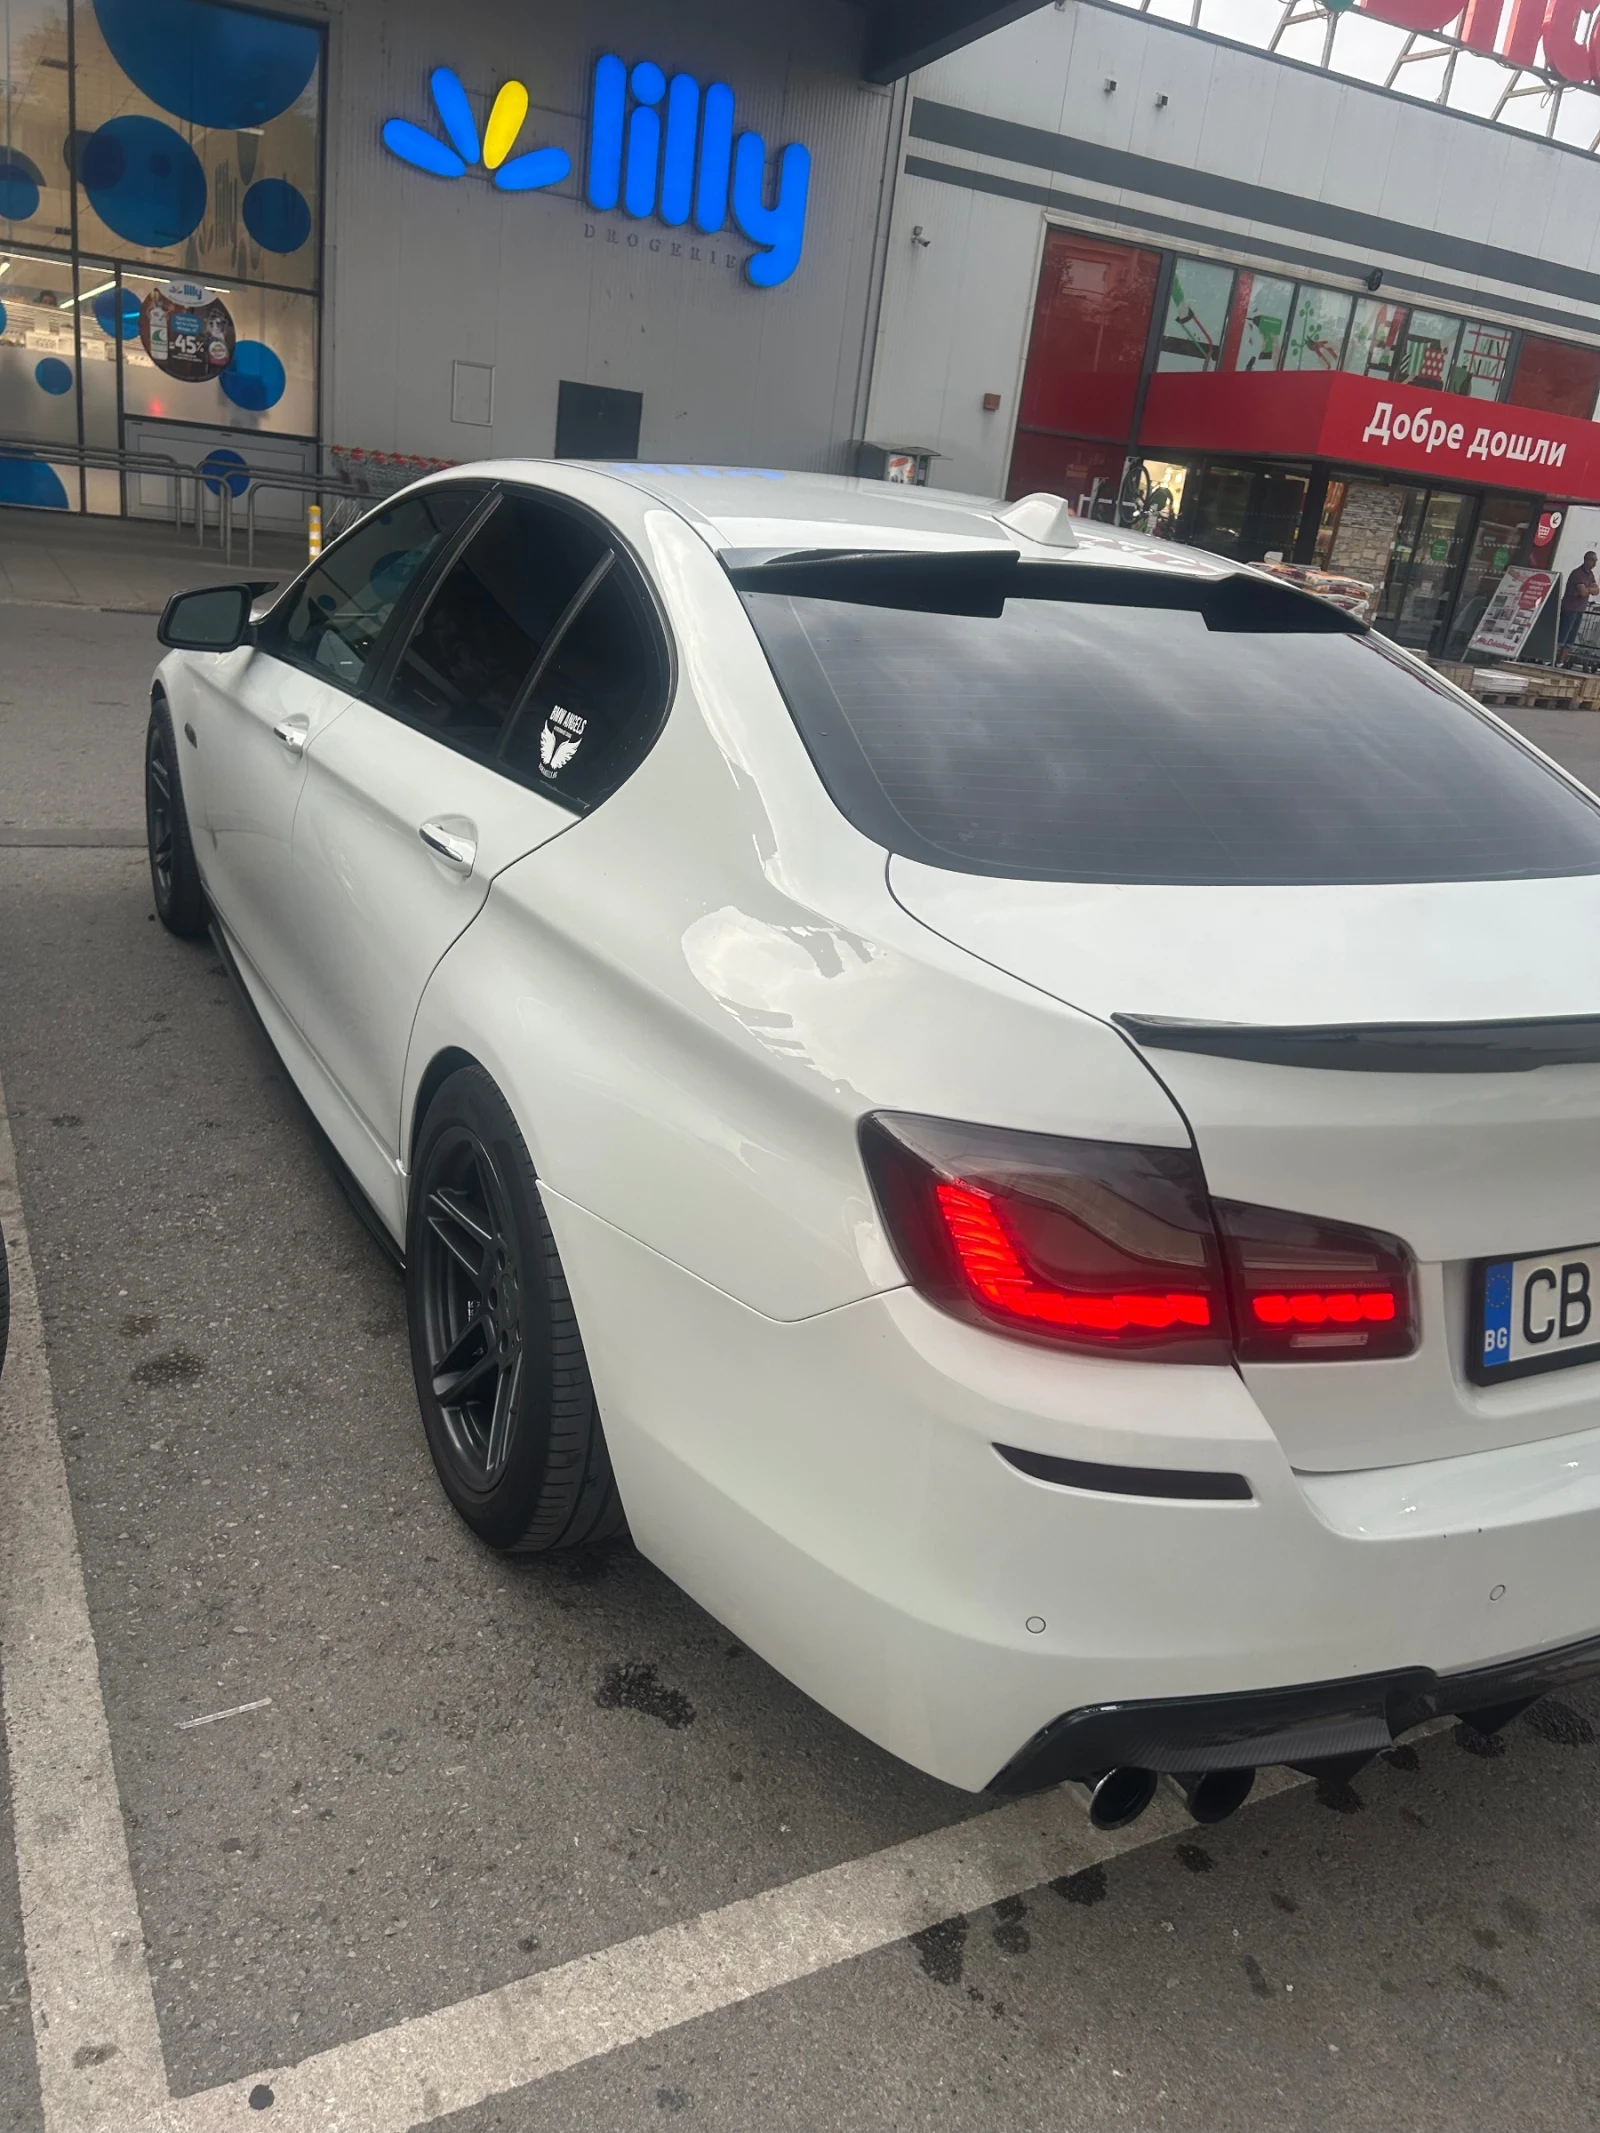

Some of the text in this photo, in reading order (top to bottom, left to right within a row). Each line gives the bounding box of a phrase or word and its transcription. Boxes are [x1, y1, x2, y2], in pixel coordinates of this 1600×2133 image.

[589, 54, 812, 287] lilly
[584, 223, 737, 268] DROGERIE
[1362, 401, 1567, 468] Добре дошли
[1523, 1262, 1592, 1344] CB
[1485, 1327, 1508, 1352] BG
